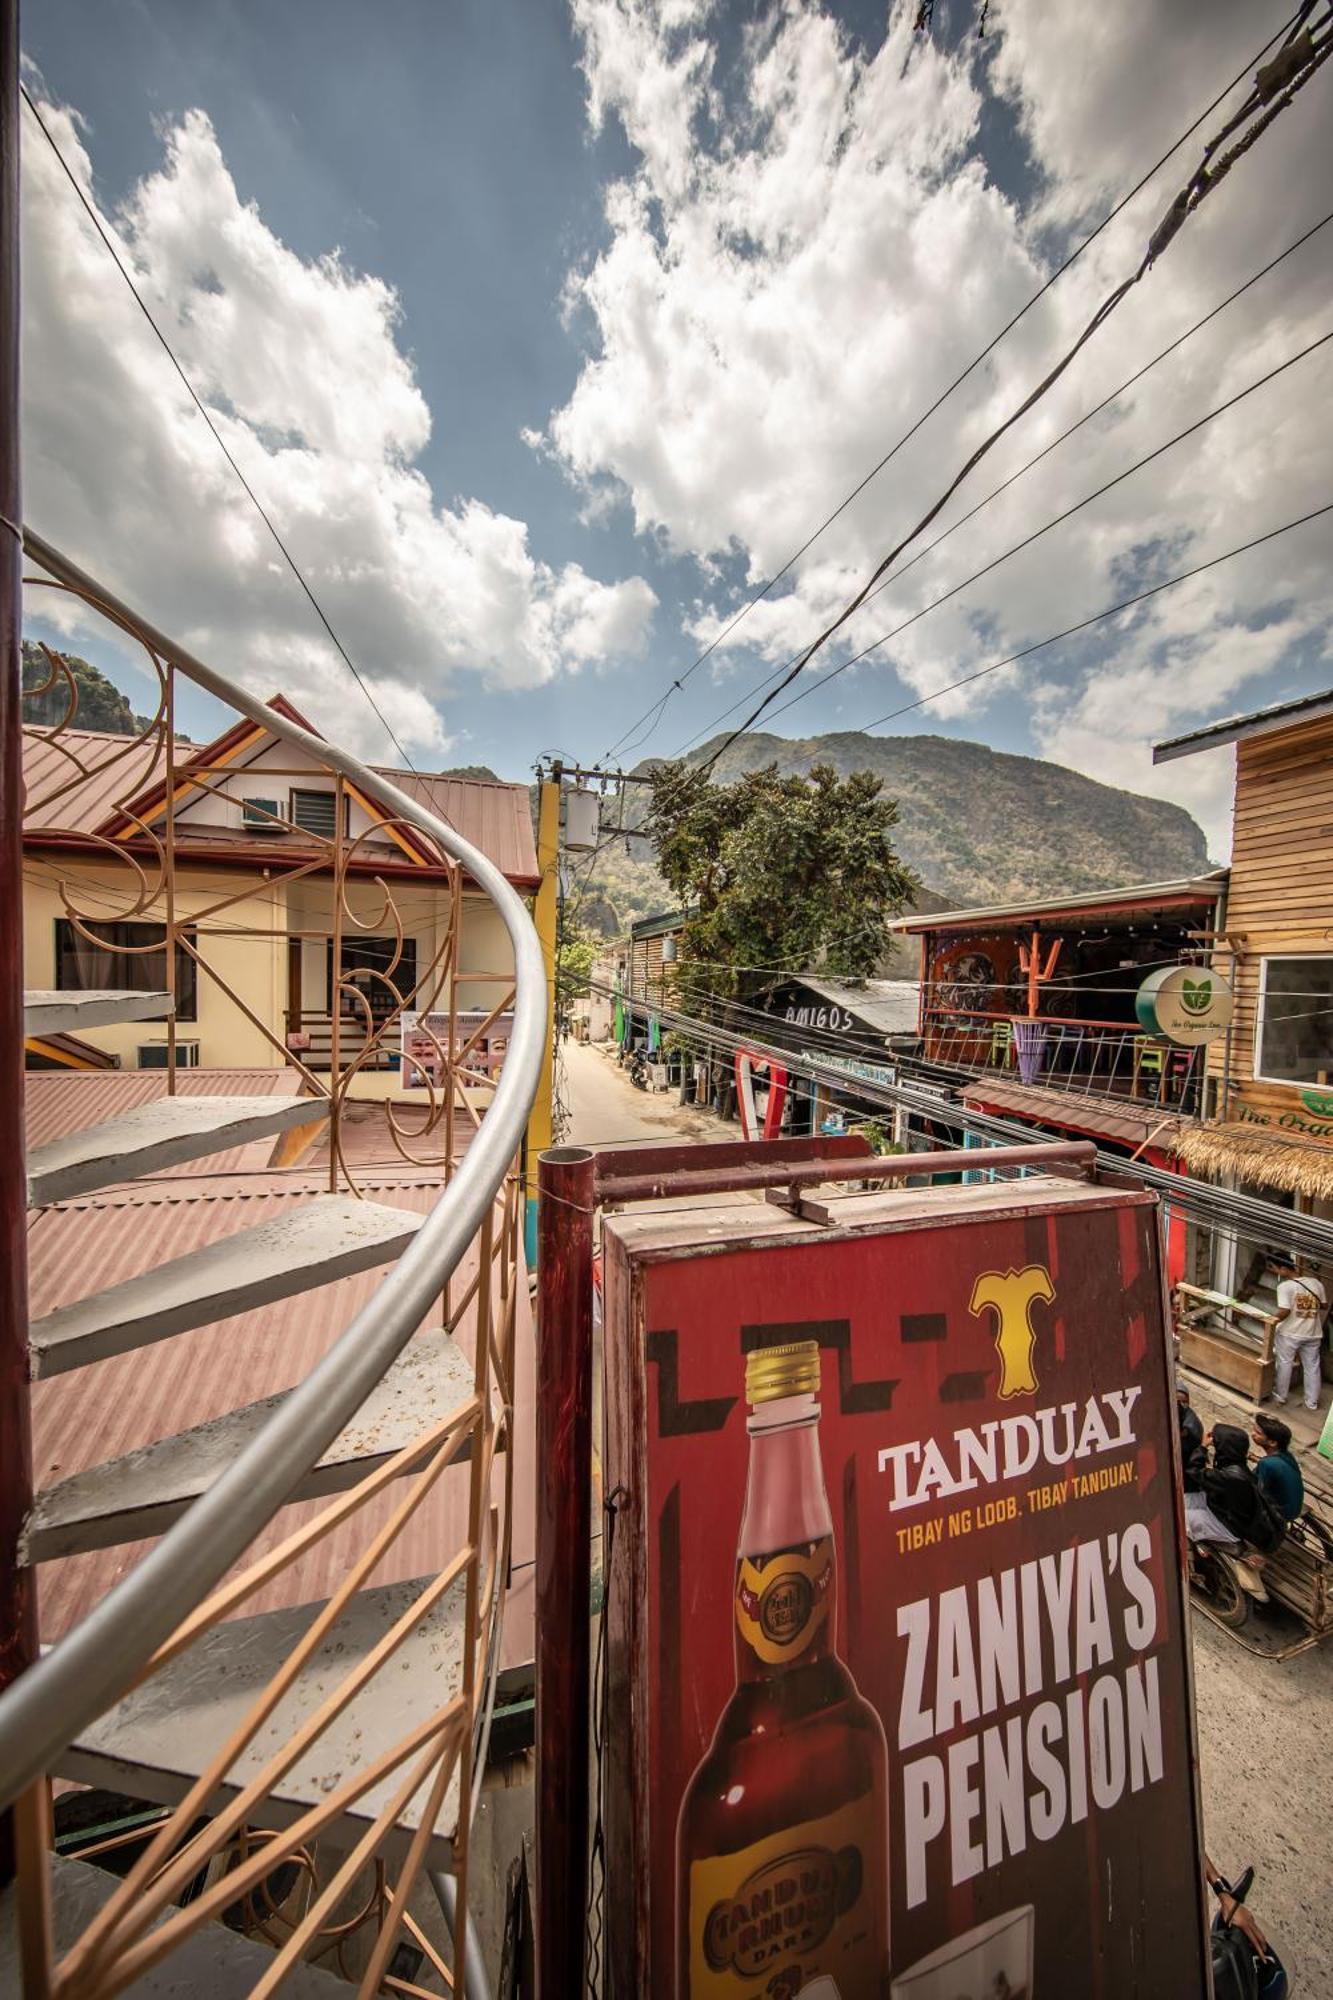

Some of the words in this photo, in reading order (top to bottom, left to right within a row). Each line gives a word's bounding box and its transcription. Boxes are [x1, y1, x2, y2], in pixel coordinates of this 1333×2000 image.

[785, 1006, 854, 1031] AMIGOS
[1239, 1107, 1272, 1126] The
[878, 1386, 1142, 1512] TANDUAY
[895, 1517, 943, 1554] TIBAY
[948, 1509, 972, 1539] NG
[976, 1496, 1023, 1530] LOOB.
[1027, 1479, 1069, 1514] TIBAY
[1071, 1461, 1139, 1500] TANDUAY.
[896, 1523, 1157, 1752] ZANIYA'S
[903, 1656, 1164, 1911] PENSION
